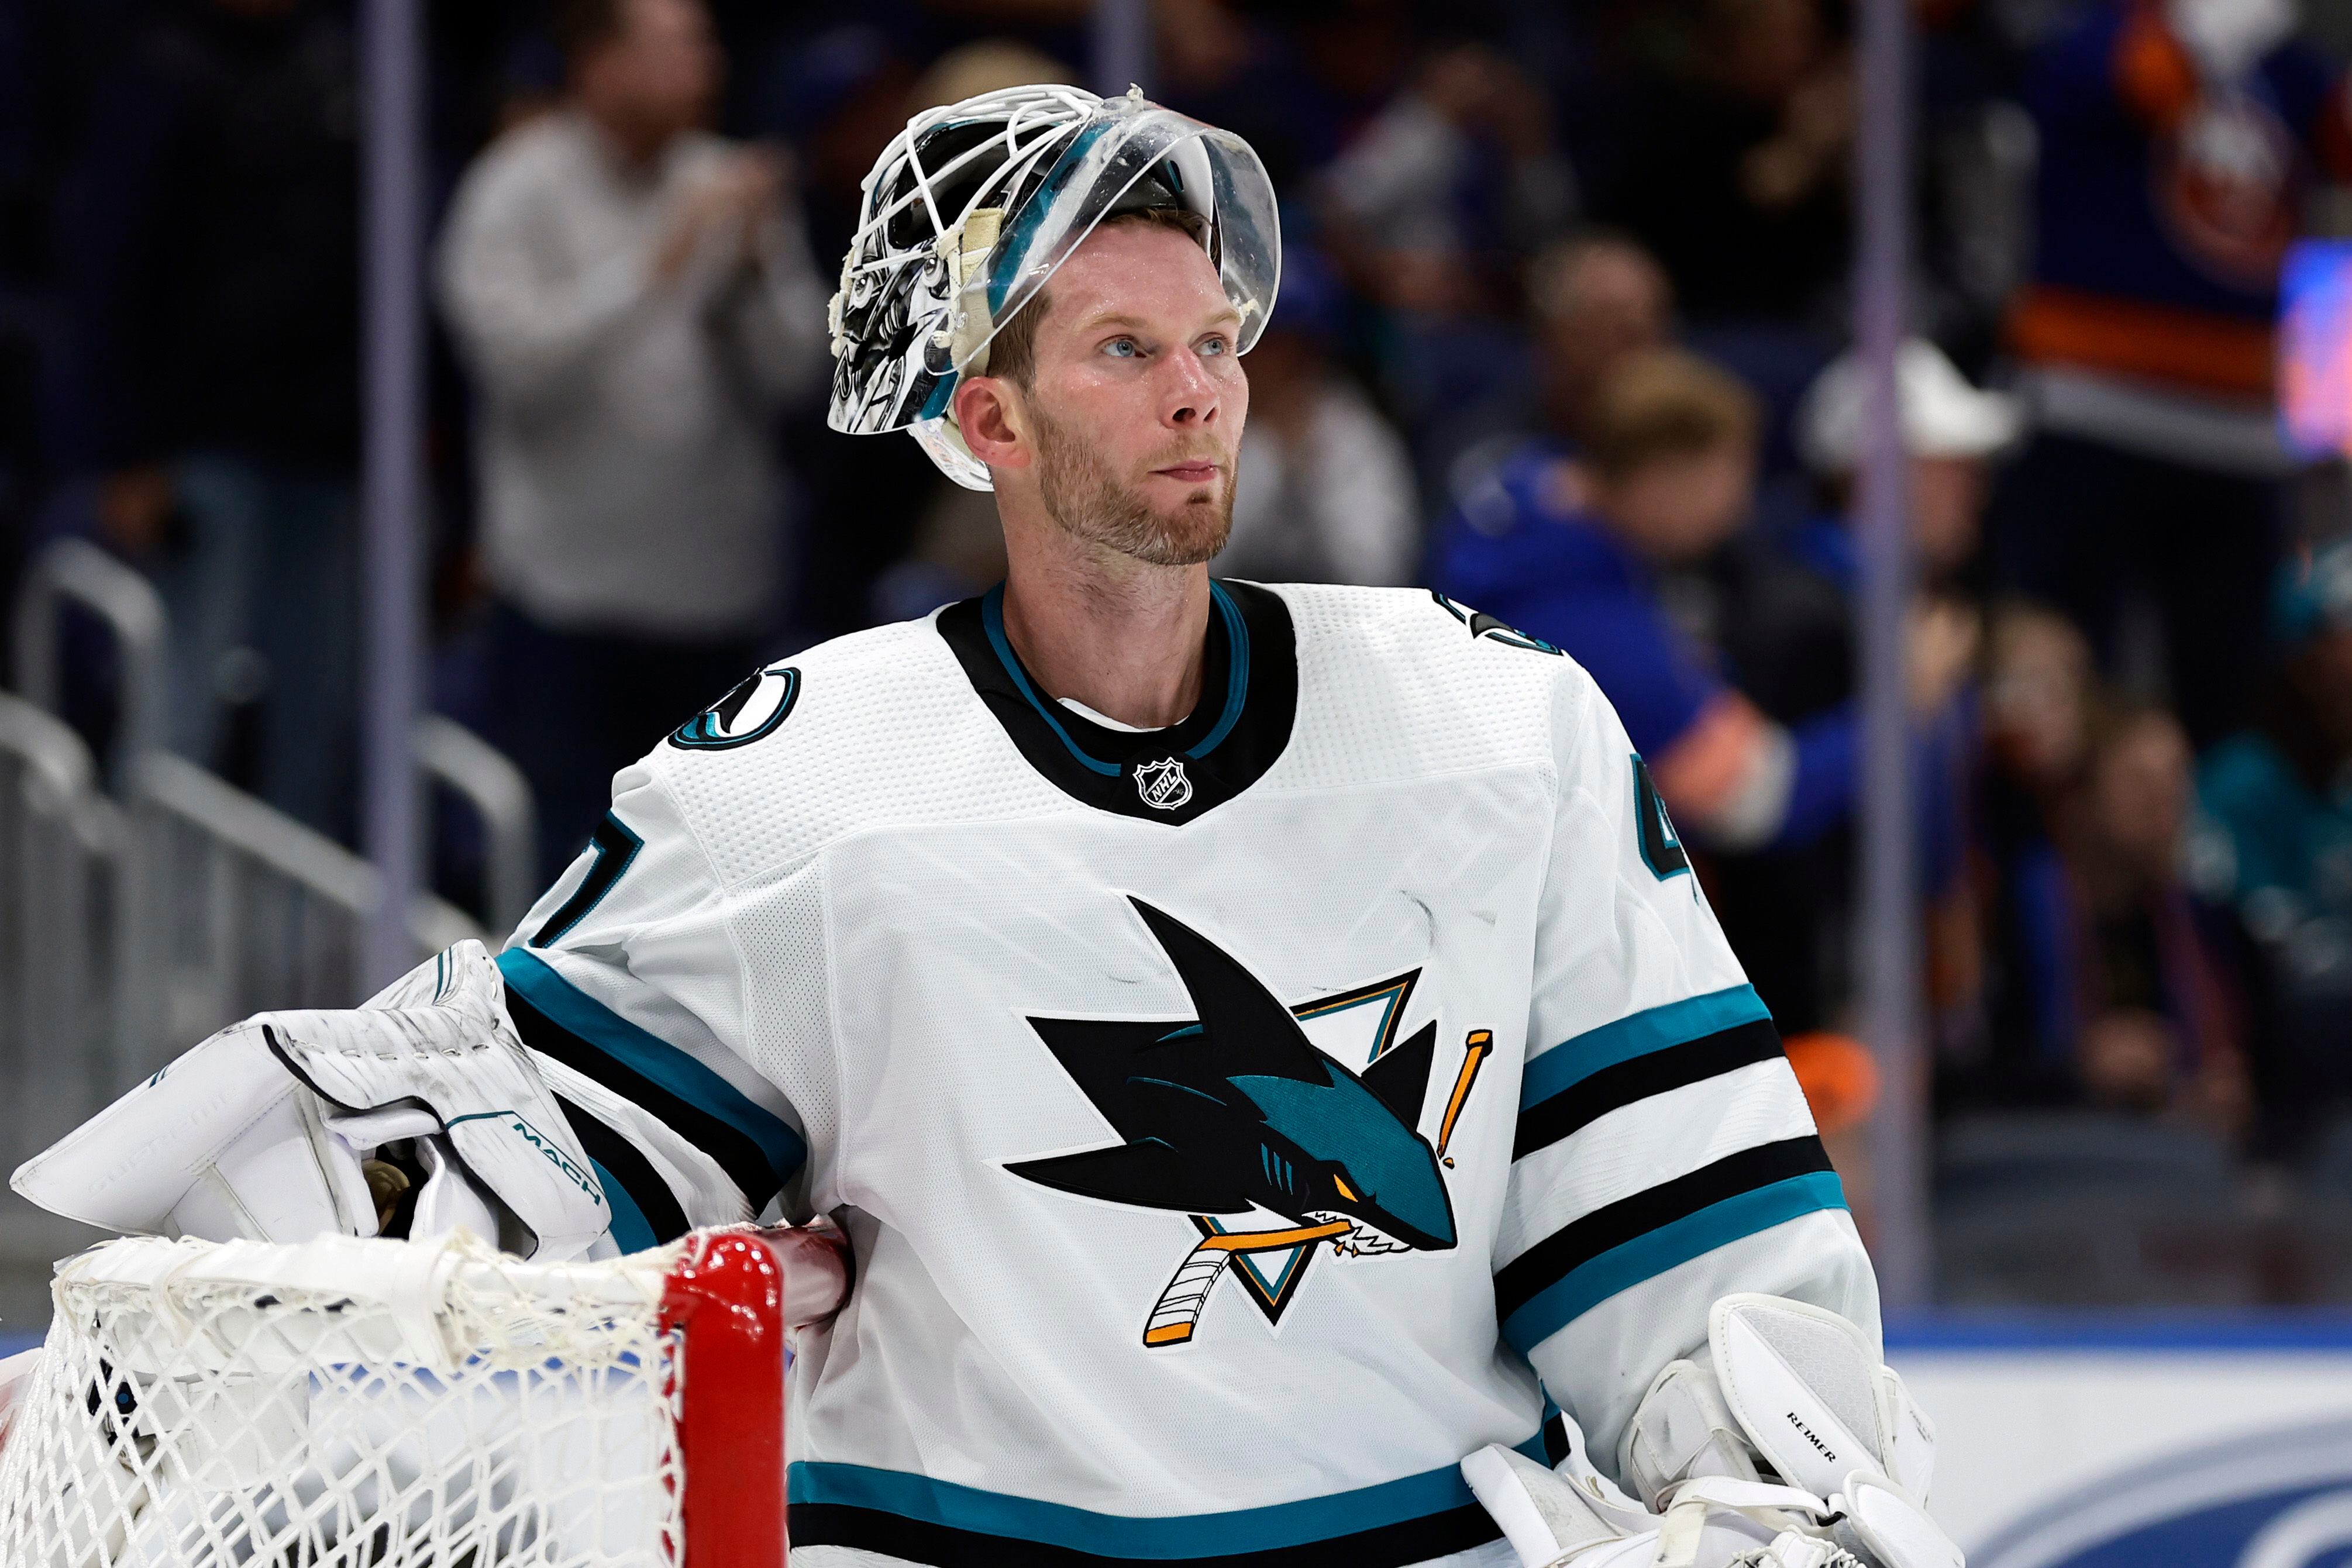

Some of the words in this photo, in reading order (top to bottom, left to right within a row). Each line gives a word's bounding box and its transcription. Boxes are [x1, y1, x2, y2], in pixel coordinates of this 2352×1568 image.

[1152, 772, 1177, 801] NHL
[512, 1123, 601, 1206] MACH
[1787, 1412, 1836, 1463] REIMER
